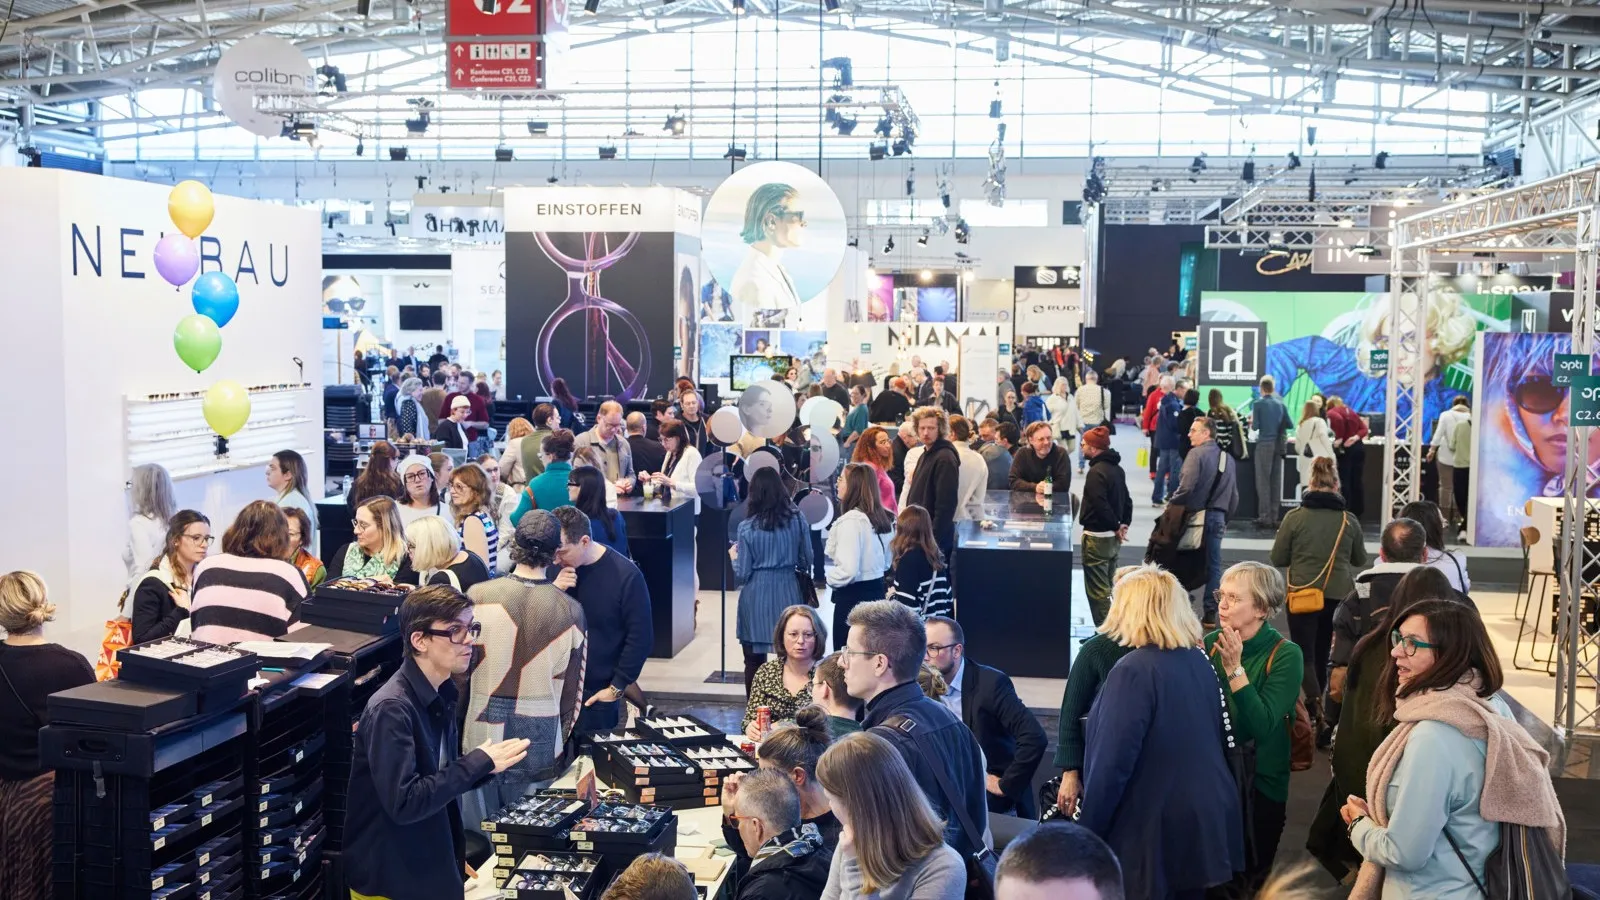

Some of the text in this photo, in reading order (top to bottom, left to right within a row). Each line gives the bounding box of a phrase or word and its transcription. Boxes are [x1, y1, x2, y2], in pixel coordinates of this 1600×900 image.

[537, 203, 642, 215] EINSTOFFEN
[71, 222, 289, 287] NEBAU
[1560, 360, 1583, 370] opti
